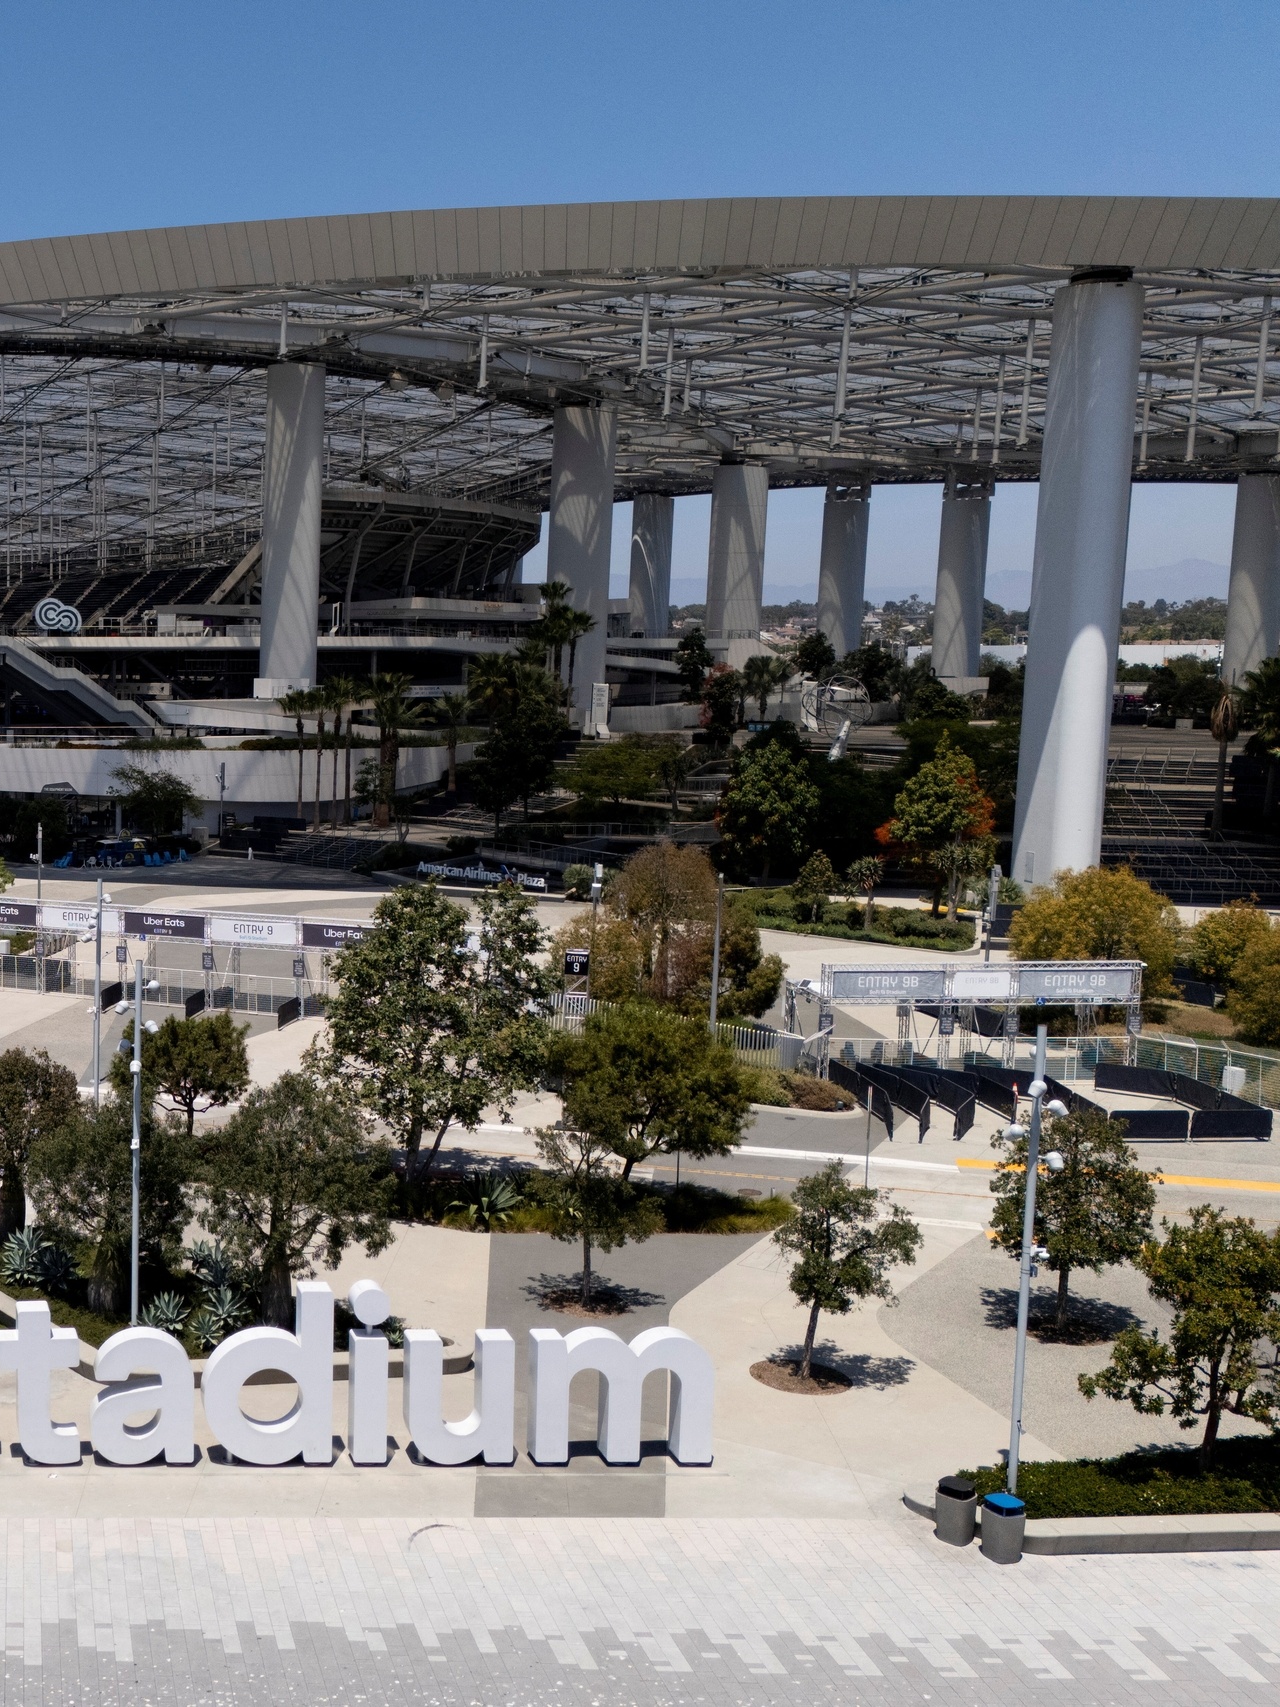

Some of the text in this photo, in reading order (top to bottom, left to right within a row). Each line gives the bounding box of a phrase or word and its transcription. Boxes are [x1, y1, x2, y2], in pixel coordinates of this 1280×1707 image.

[417, 861, 545, 887] American Airlines Plaza
[0, 905, 19, 916] Eats
[62, 911, 90, 922] ENTRY
[143, 916, 185, 928] Uber Eats
[233, 923, 274, 935] ENTRY 9
[323, 928, 346, 938] Uber
[566, 955, 588, 963] ENTRY
[573, 962, 580, 973] 9
[858, 976, 919, 988] ENTRY 9B
[1044, 974, 1106, 987] ENTRY 9B
